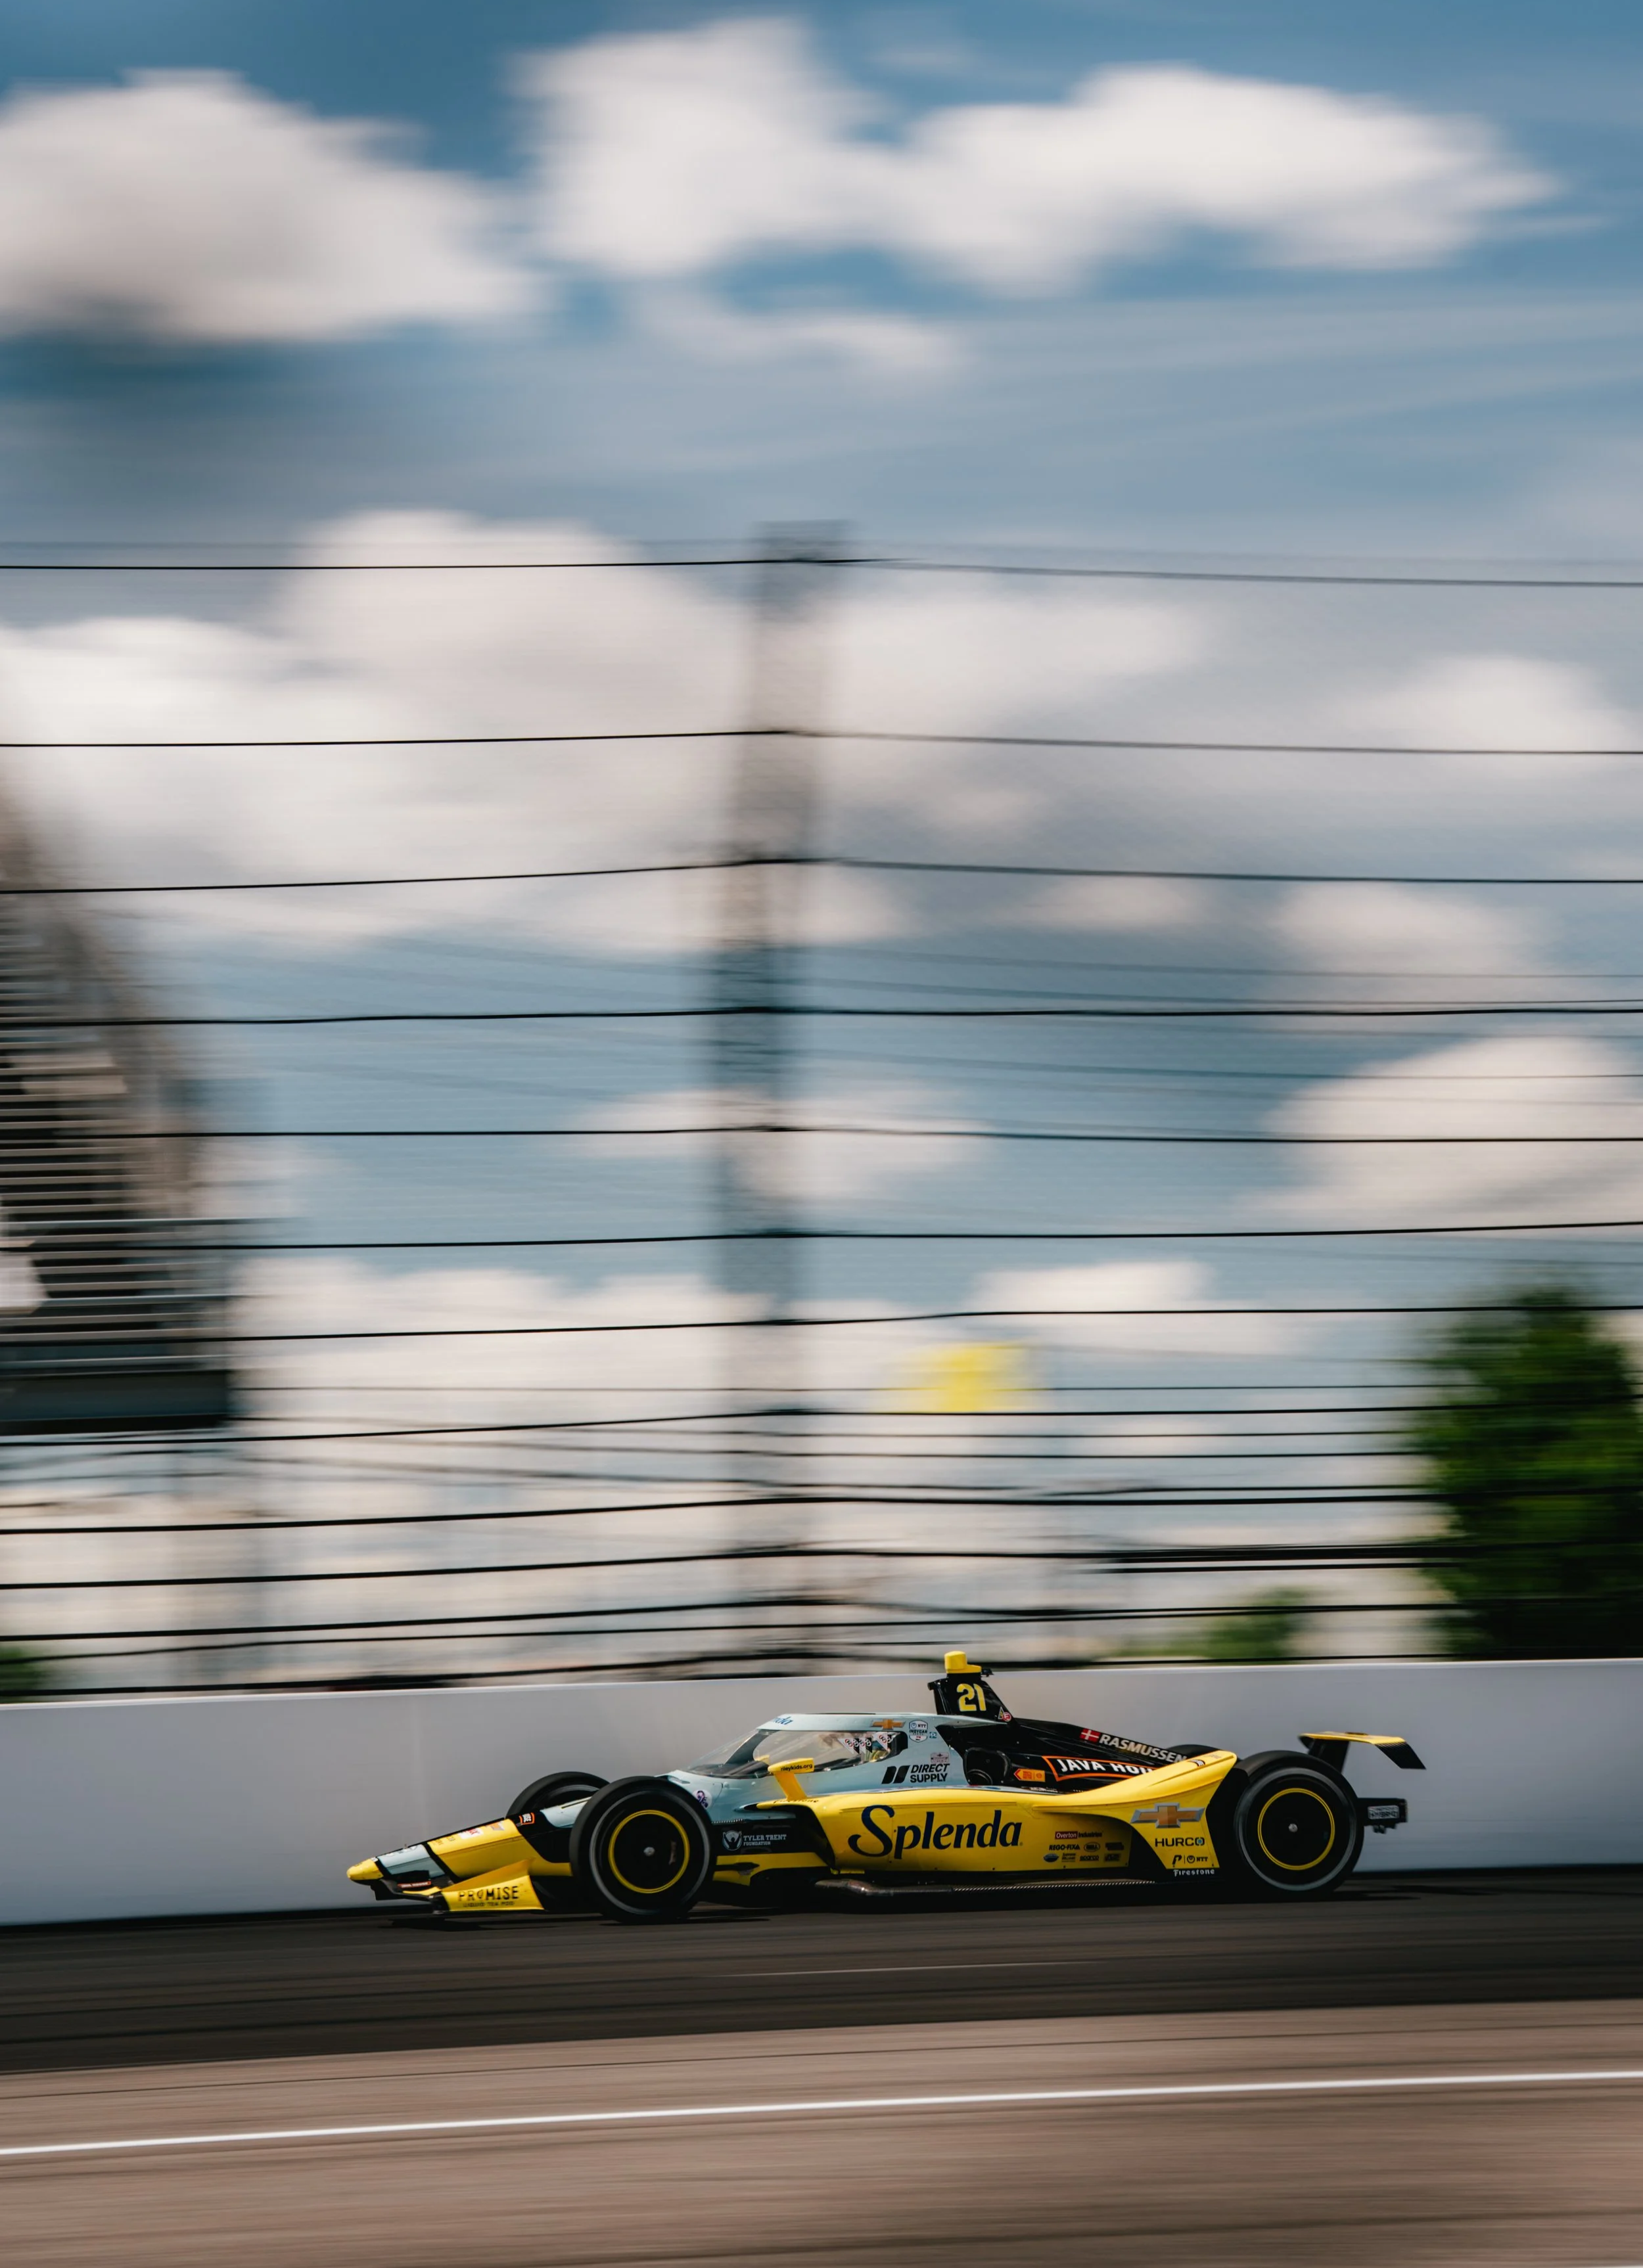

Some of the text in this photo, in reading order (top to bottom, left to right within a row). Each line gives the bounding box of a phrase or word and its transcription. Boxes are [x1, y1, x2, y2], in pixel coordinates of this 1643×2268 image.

[957, 1683, 986, 1712] 21
[1099, 1734, 1187, 1763] RASMUSSEN
[780, 1763, 813, 1772] rileykids.org
[911, 1763, 950, 1773] DIRECT
[1057, 1759, 1106, 1772] JAVA
[910, 1773, 948, 1783] SUPPLY
[848, 1805, 1022, 1859] Splenda
[1155, 1837, 1205, 1847] HURCO
[457, 1886, 519, 1901] PROMISE
